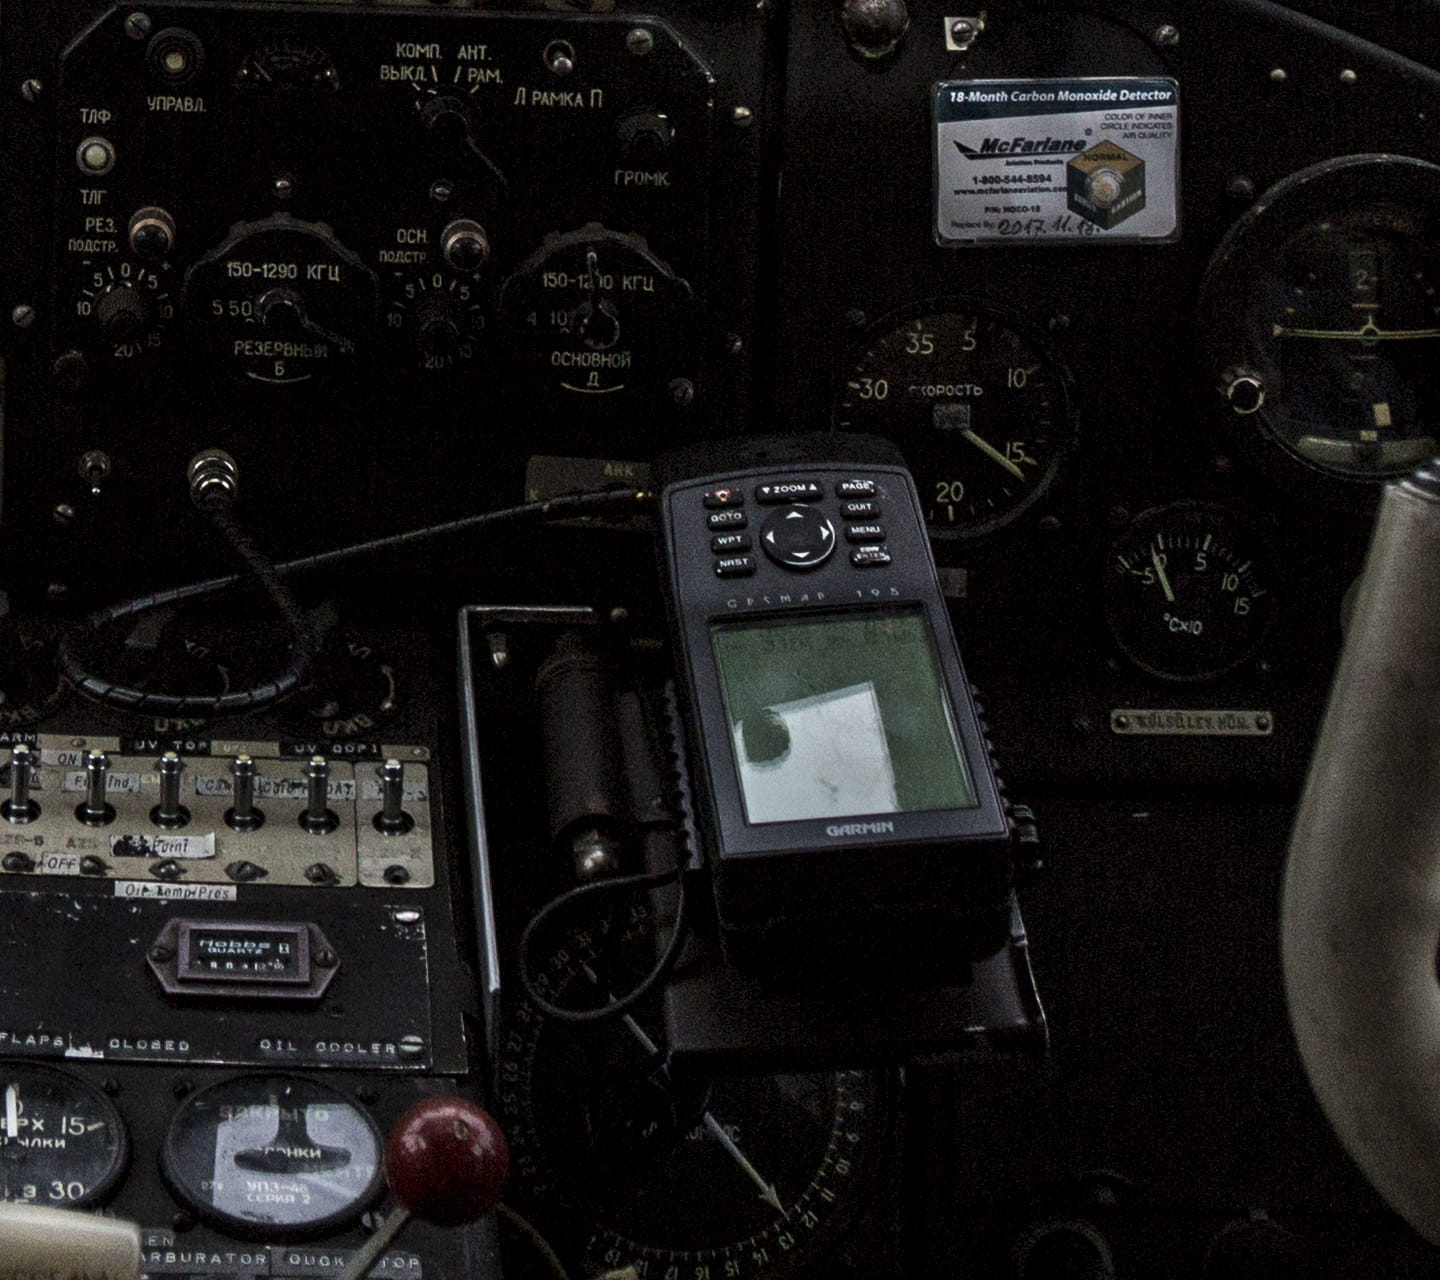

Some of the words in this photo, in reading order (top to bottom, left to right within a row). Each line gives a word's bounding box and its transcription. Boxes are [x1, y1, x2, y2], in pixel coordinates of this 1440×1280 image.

[395, 43, 443, 59] КОМП.
[457, 45, 493, 61] АНТ.
[380, 65, 427, 82] ВЫКЛ.
[467, 67, 505, 84] РАМ.
[531, 89, 584, 108] РАМКА
[950, 91, 1008, 103] 18-Month
[1011, 91, 1054, 103] Carbon
[1057, 90, 1118, 102] Monoxide
[1119, 89, 1172, 101] Detector
[146, 96, 208, 113] УПРАВЛ.
[80, 108, 112, 124] ТЛФ
[1131, 122, 1173, 130] INDICATES
[980, 138, 1087, 153] McFarlane
[1083, 152, 1128, 162] NORMAL
[614, 169, 672, 186] ГРОМК.
[85, 217, 118, 233] РЕЗ.
[68, 238, 119, 253] ПОДСТР.
[378, 249, 431, 264] ПОДСТР.
[226, 262, 298, 280] 150-1290
[306, 263, 340, 283] КГЦ
[542, 272, 614, 289] 150-120
[622, 274, 655, 293] КГЦ
[906, 333, 935, 355] 35
[1007, 368, 1027, 388] 10
[859, 378, 889, 400] 30
[1005, 441, 1026, 463] 15
[773, 483, 807, 494] ZOOM
[842, 482, 870, 490] PAGE
[935, 480, 965, 503] 20
[848, 503, 872, 512] QUIT
[710, 512, 742, 523] GOTO
[851, 525, 880, 534] MENU
[717, 535, 743, 545] WPT
[719, 558, 749, 568] NRST
[1221, 573, 1239, 592] 10
[856, 587, 900, 598] 195
[0, 733, 37, 743] ARM
[57, 752, 77, 766] ON
[825, 821, 895, 837] GARMIN
[46, 854, 77, 869] OFF
[199, 939, 271, 950] Hobbs
[207, 947, 264, 955] QUARTZ
[108, 1038, 191, 1052] CLOSED
[259, 1039, 298, 1053] OIL
[315, 1041, 397, 1055] COOLER
[61, 1115, 86, 1136] 15
[48, 1180, 86, 1201] 30
